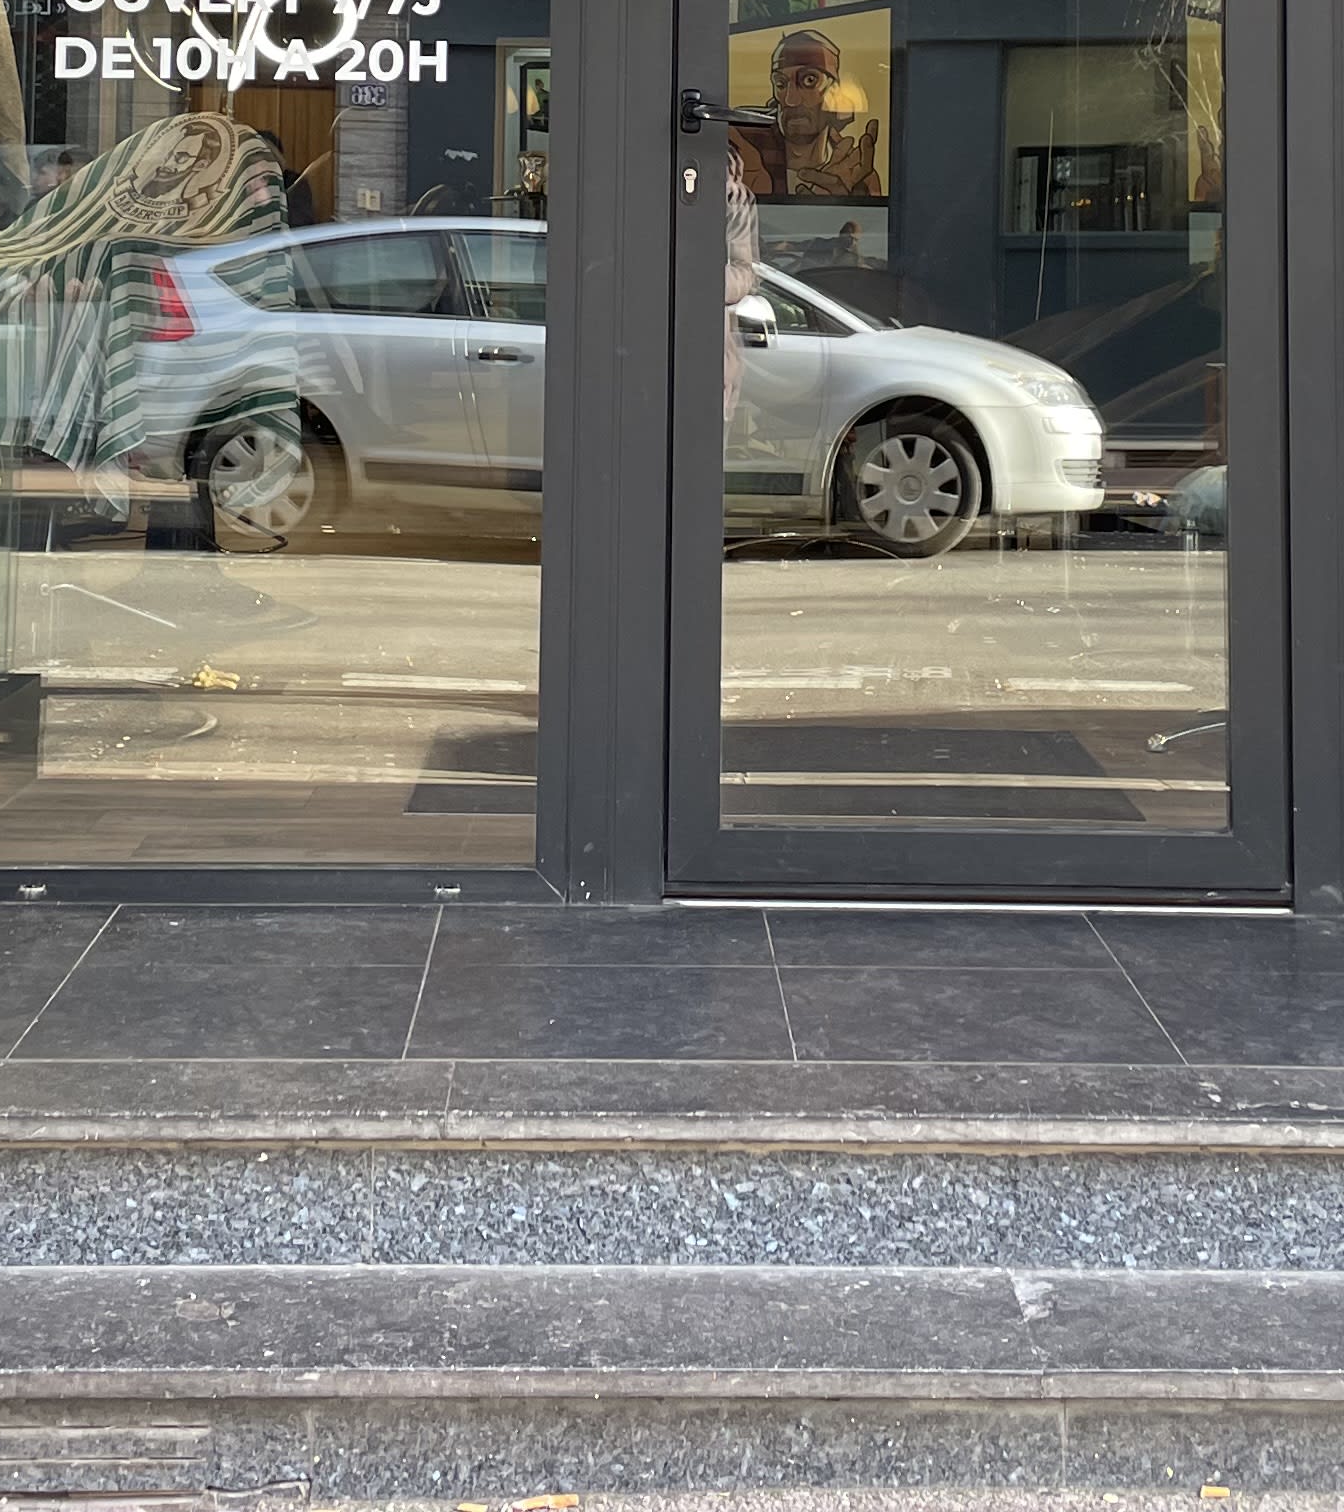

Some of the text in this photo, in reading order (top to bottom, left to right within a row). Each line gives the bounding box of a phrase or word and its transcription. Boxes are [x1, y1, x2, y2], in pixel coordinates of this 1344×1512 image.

[54, 35, 449, 83] DE 10H A 20H
